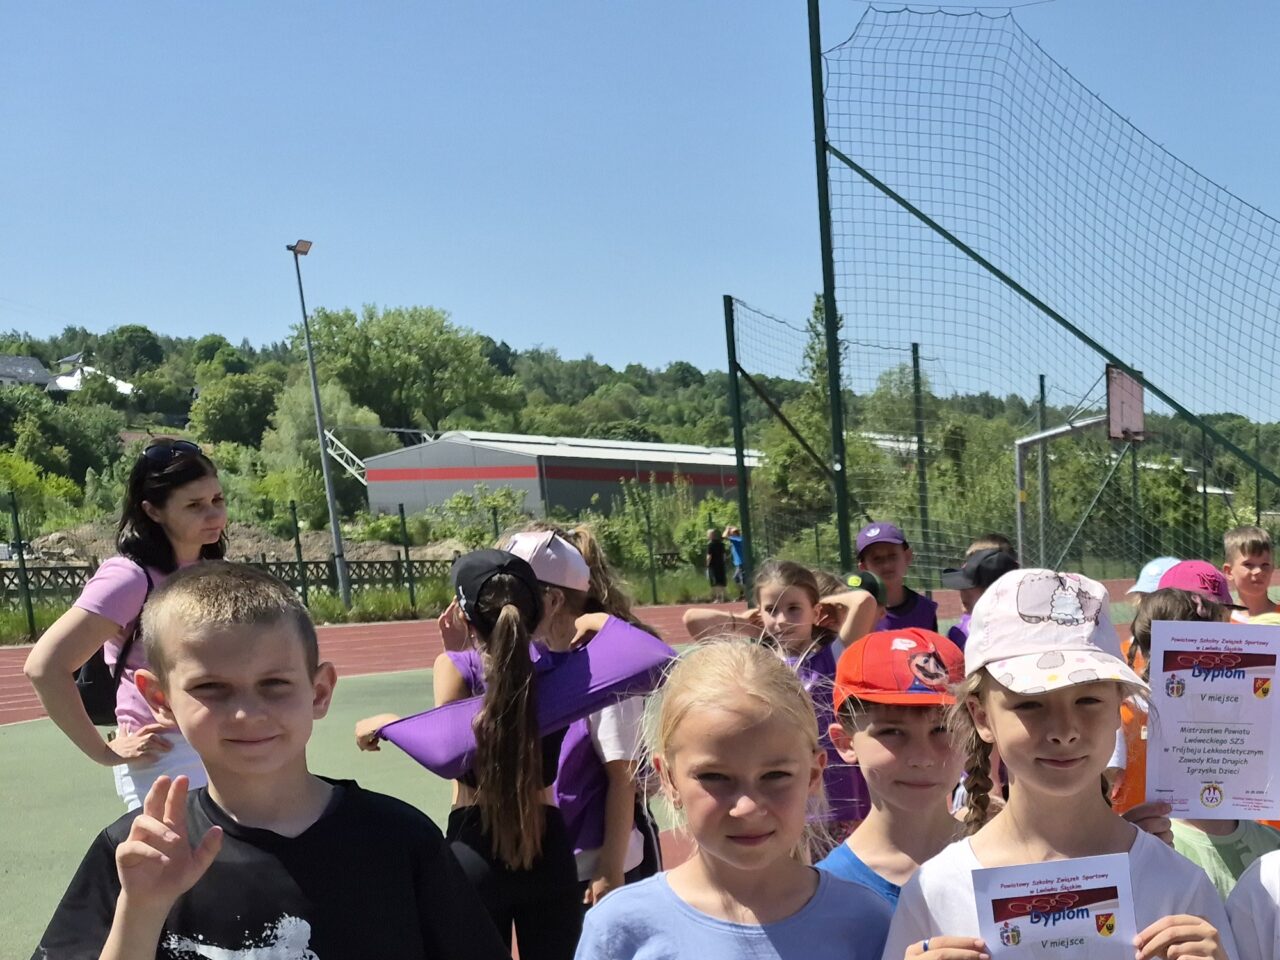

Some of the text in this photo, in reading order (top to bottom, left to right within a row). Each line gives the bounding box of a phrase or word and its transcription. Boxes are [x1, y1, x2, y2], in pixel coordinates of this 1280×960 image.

[1192, 664, 1245, 681] Dyplom
[1201, 694, 1239, 704] V miejsce
[1203, 748, 1264, 756] Lekkoatletycznym
[1179, 756, 1204, 764] Zawody
[1222, 758, 1248, 766] Drugich
[1187, 767, 1216, 775] Igrzyska
[1030, 907, 1089, 927] Dyplom
[1050, 938, 1084, 949] miejsce
